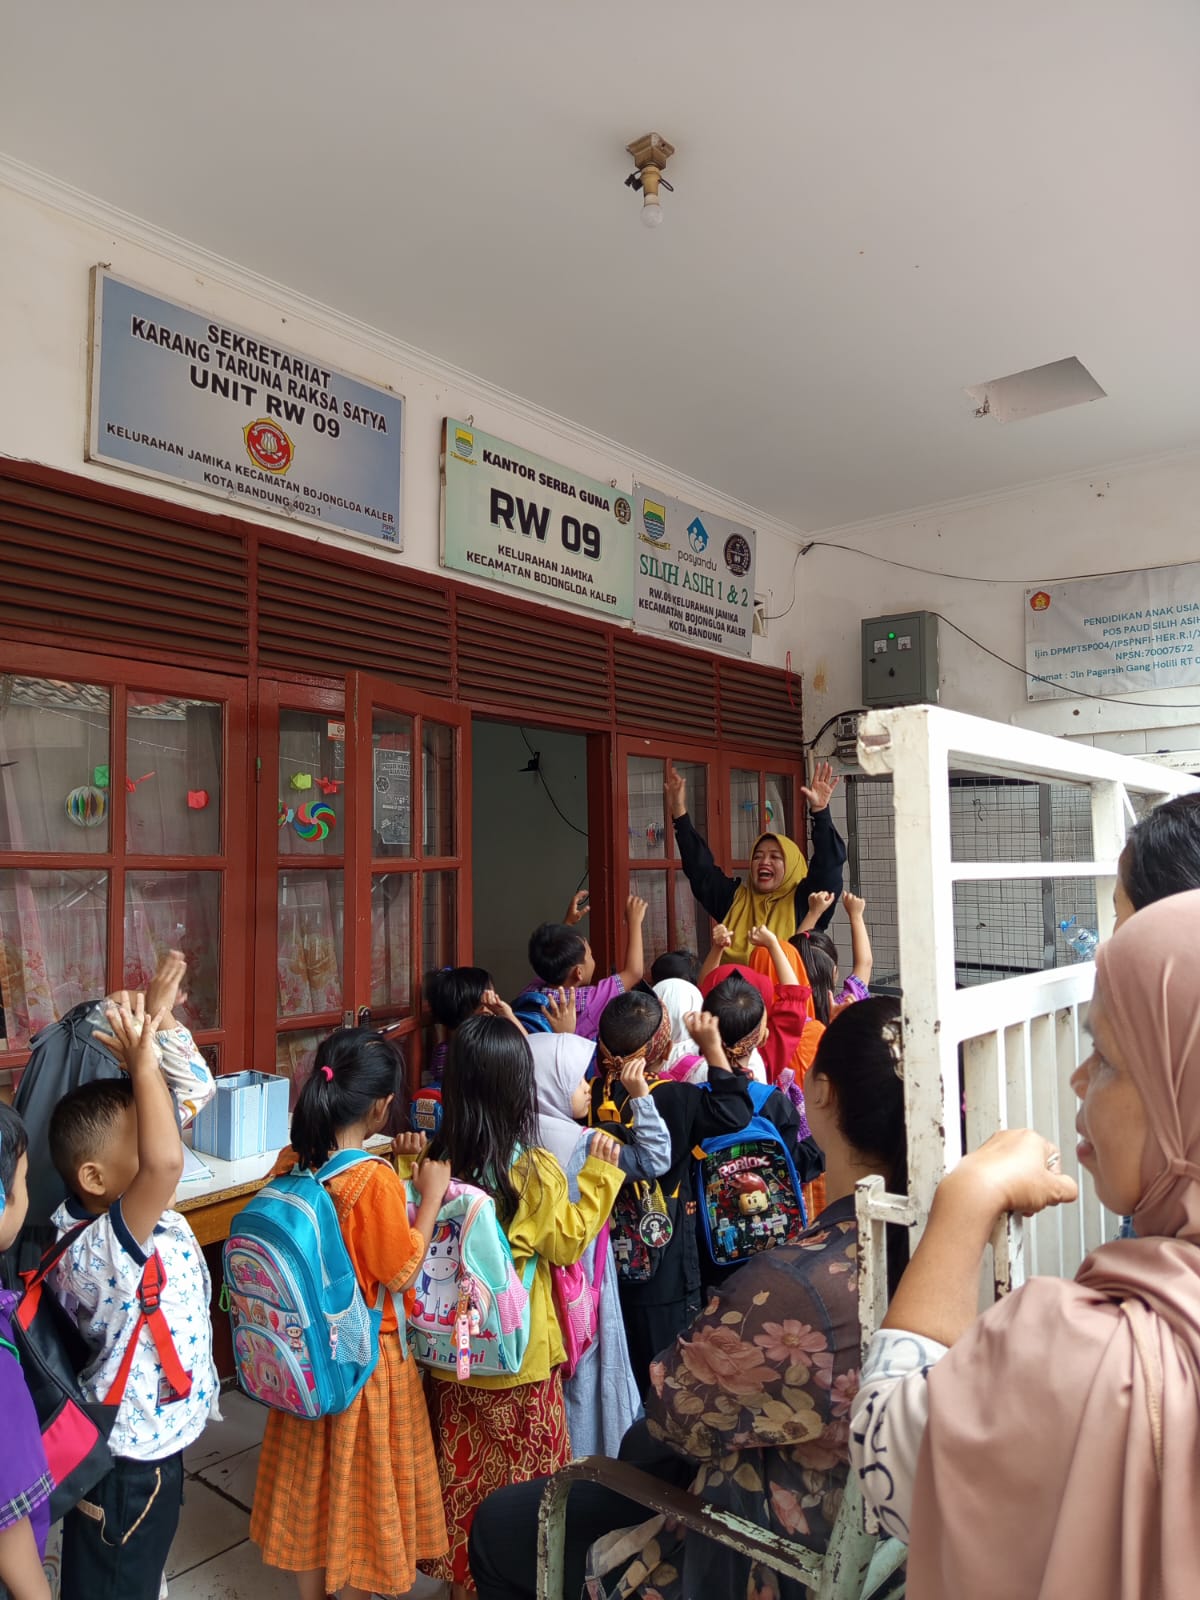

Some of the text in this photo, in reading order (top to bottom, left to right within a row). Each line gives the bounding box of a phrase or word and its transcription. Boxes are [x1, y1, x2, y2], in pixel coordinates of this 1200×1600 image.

[132, 316, 387, 433] KARANG TARUNA RAKSA SATYA
[207, 324, 331, 389] SEKRETARIAT
[190, 364, 257, 407] UNIT
[266, 393, 306, 425] RW
[312, 412, 340, 438] 09
[106, 422, 184, 457] KELURAHAN
[187, 449, 232, 472] JAMIKA
[235, 463, 300, 493] KECAMATAN
[303, 486, 362, 514] BOJONGLOA
[364, 505, 394, 523] KALER
[203, 471, 322, 517] KOTA BANDUNG 40231
[482, 449, 536, 482] KANTOR
[538, 472, 577, 498] SERBA
[579, 490, 610, 512] GUNA
[490, 487, 601, 559] RW 09
[466, 550, 617, 606] KECAMATAN BOJONGLOA KALER
[497, 544, 594, 584] KELURAHAN JAMIKA
[639, 553, 749, 607] SILIH ASIH 1 & 2
[677, 550, 718, 572] posyandu
[638, 597, 746, 638] KECAMATAN BOJONGLOA KALER
[671, 594, 714, 616] KELURAHAN
[715, 607, 739, 623] JAMIKA
[1083, 602, 1200, 626] PENDIDIKAN ANAK USIA
[1103, 627, 1122, 637] POS
[1124, 623, 1150, 634] PAUD
[1152, 618, 1177, 630] SILIH
[668, 619, 723, 643] KOTA BANDUNG
[1031, 673, 1063, 682] Alamat
[1086, 665, 1124, 678] Pagarsih
[1126, 664, 1151, 672] Gang
[1152, 658, 1178, 670] Holili
[1180, 657, 1193, 666] RT
[1034, 649, 1049, 659] Ijin
